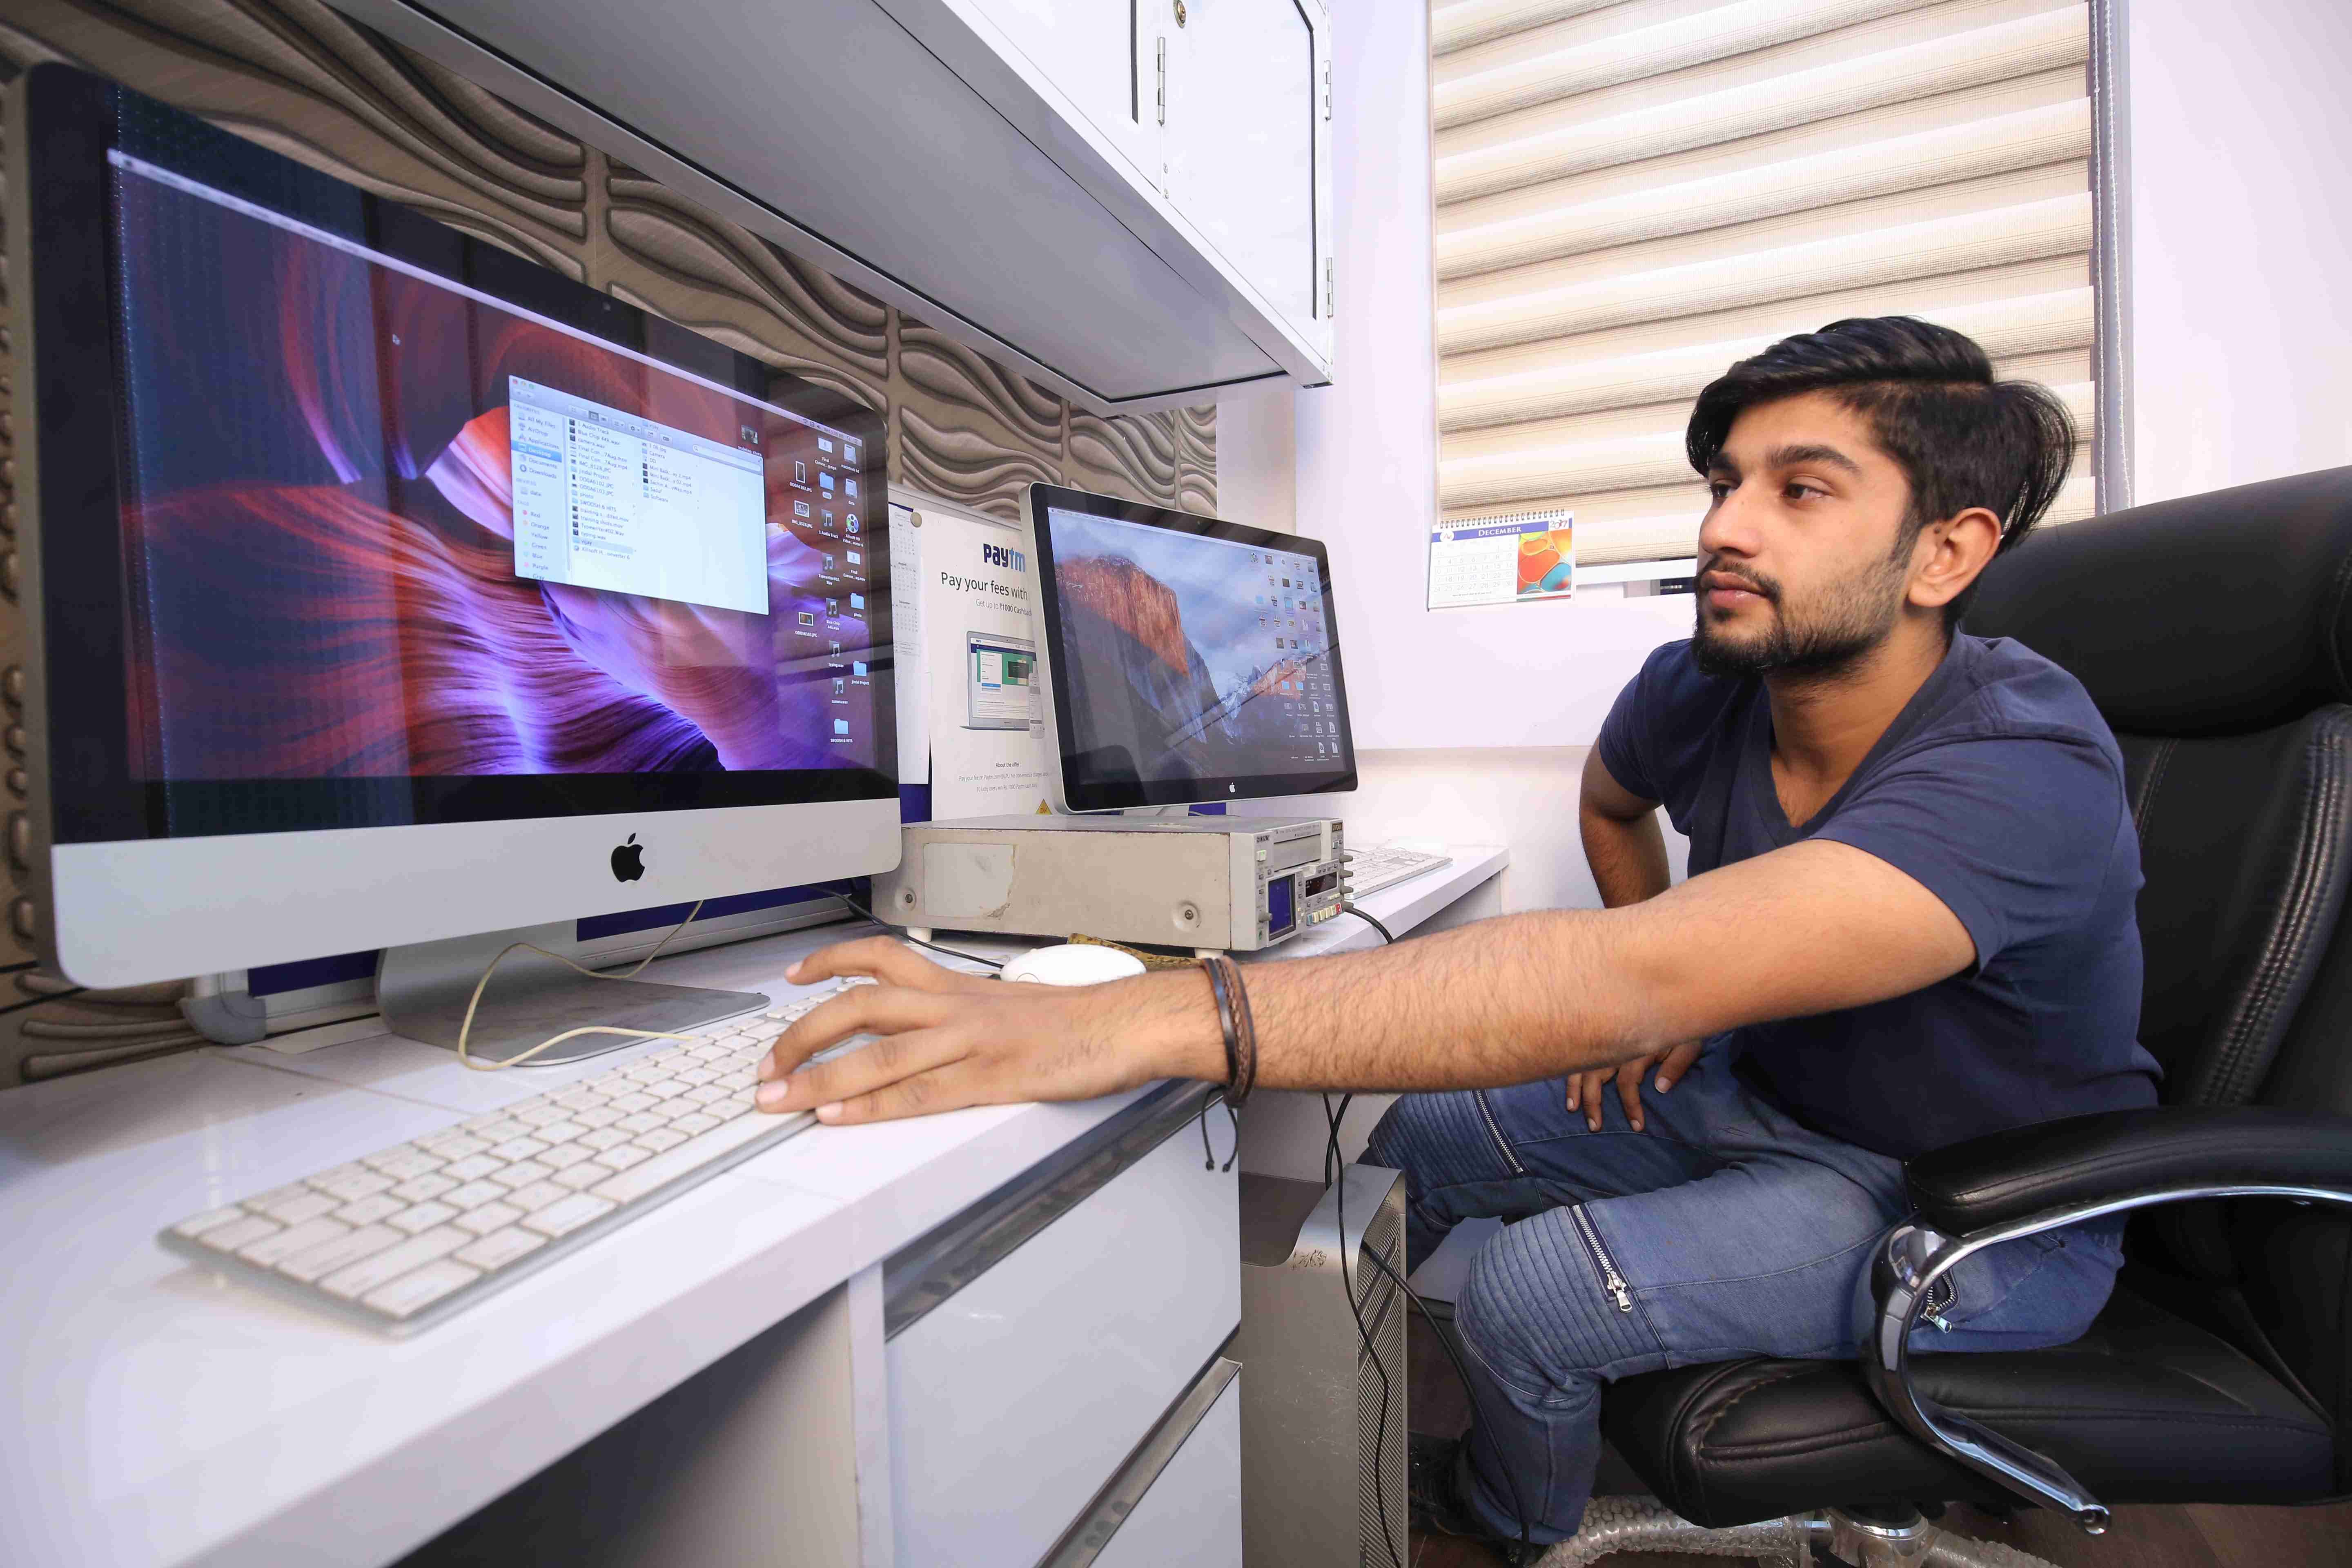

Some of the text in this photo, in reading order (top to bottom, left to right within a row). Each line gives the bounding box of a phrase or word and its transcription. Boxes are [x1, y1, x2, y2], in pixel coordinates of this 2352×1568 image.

[528, 427, 548, 437] AirDrop
[528, 437, 559, 449] Applications
[529, 457, 557, 469] Documents
[529, 468, 557, 479] Downloads
[593, 472, 609, 480] Project
[581, 516, 599, 524] training
[531, 522, 549, 530] Orange
[941, 572, 1028, 600] Pay your fees with
[976, 599, 984, 607] Get
